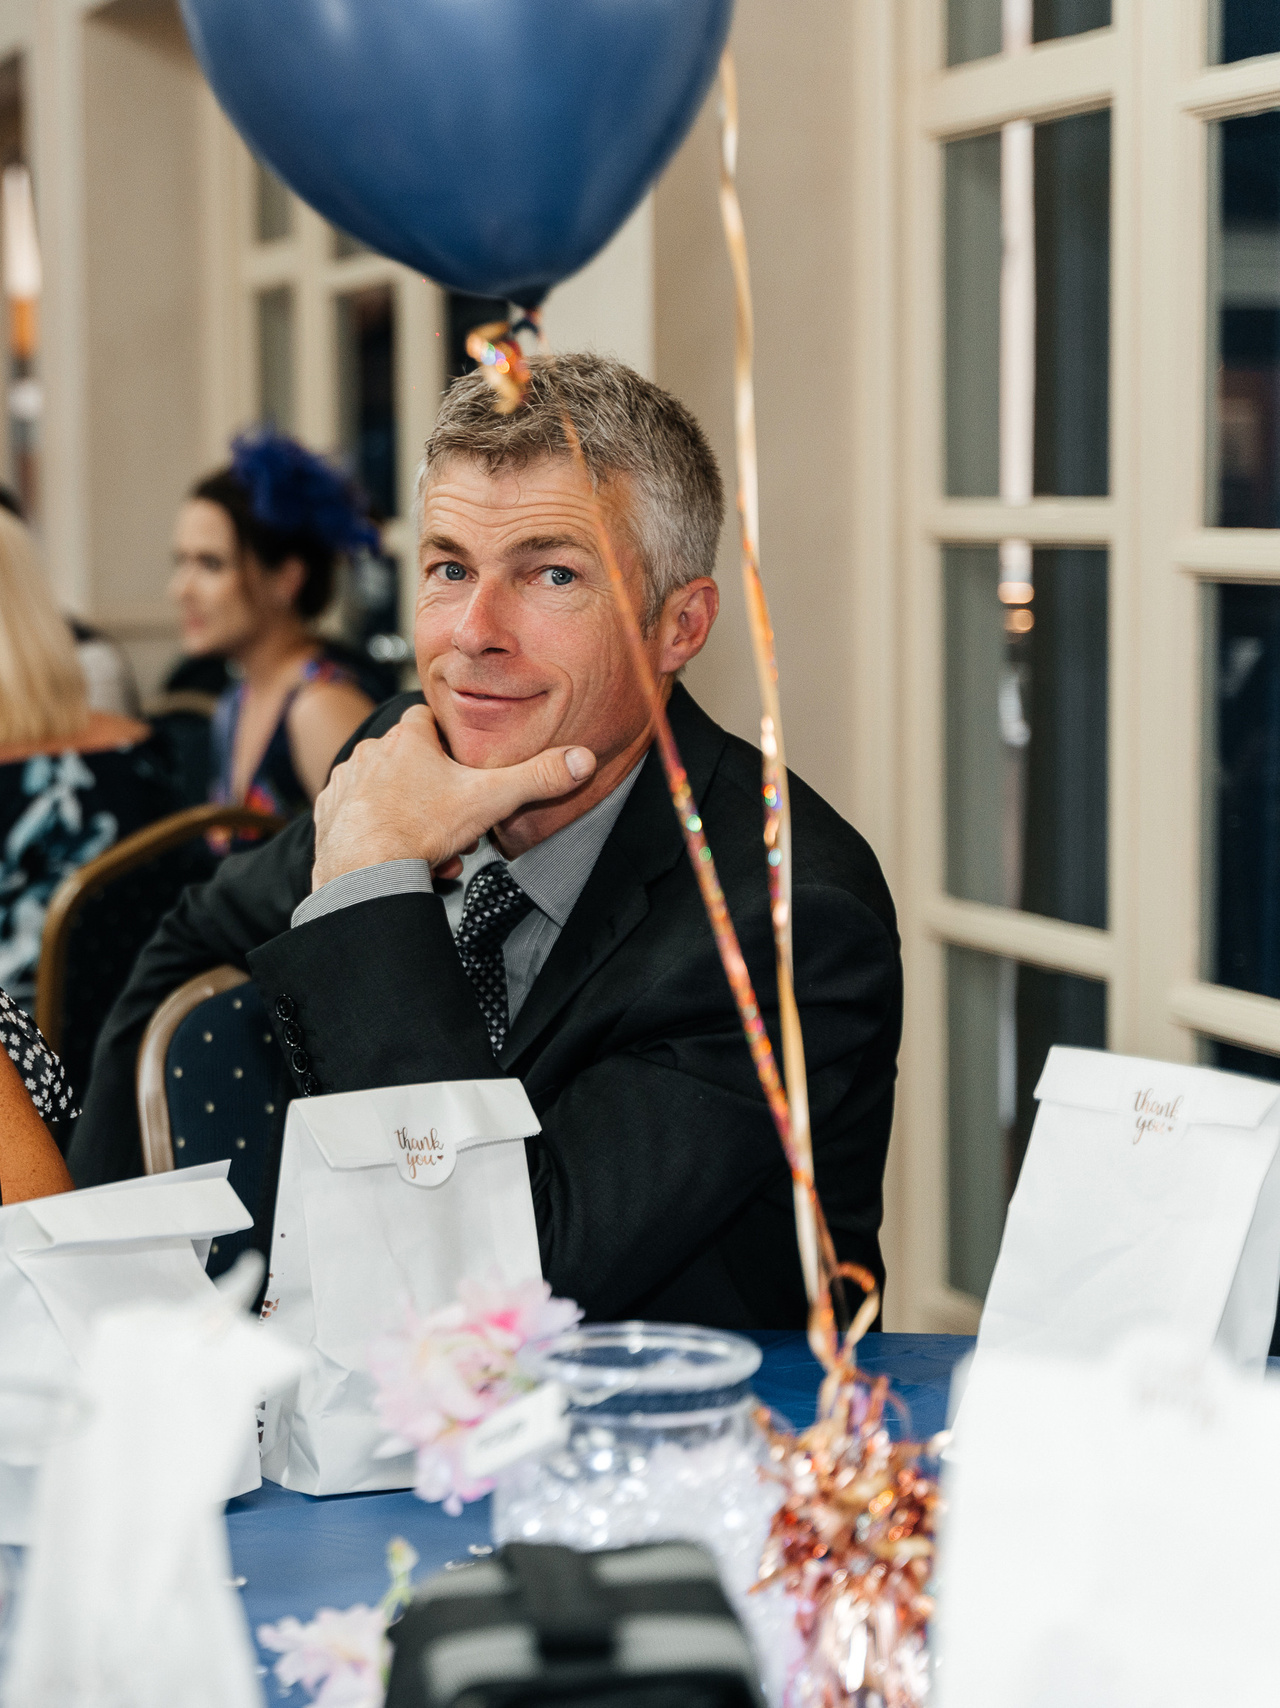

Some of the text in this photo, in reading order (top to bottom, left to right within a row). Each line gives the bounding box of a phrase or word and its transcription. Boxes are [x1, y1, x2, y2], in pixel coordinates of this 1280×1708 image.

[1133, 1087, 1184, 1119] thank
[394, 1126, 444, 1151] thank
[1132, 1116, 1166, 1146] you
[406, 1152, 437, 1179] you
